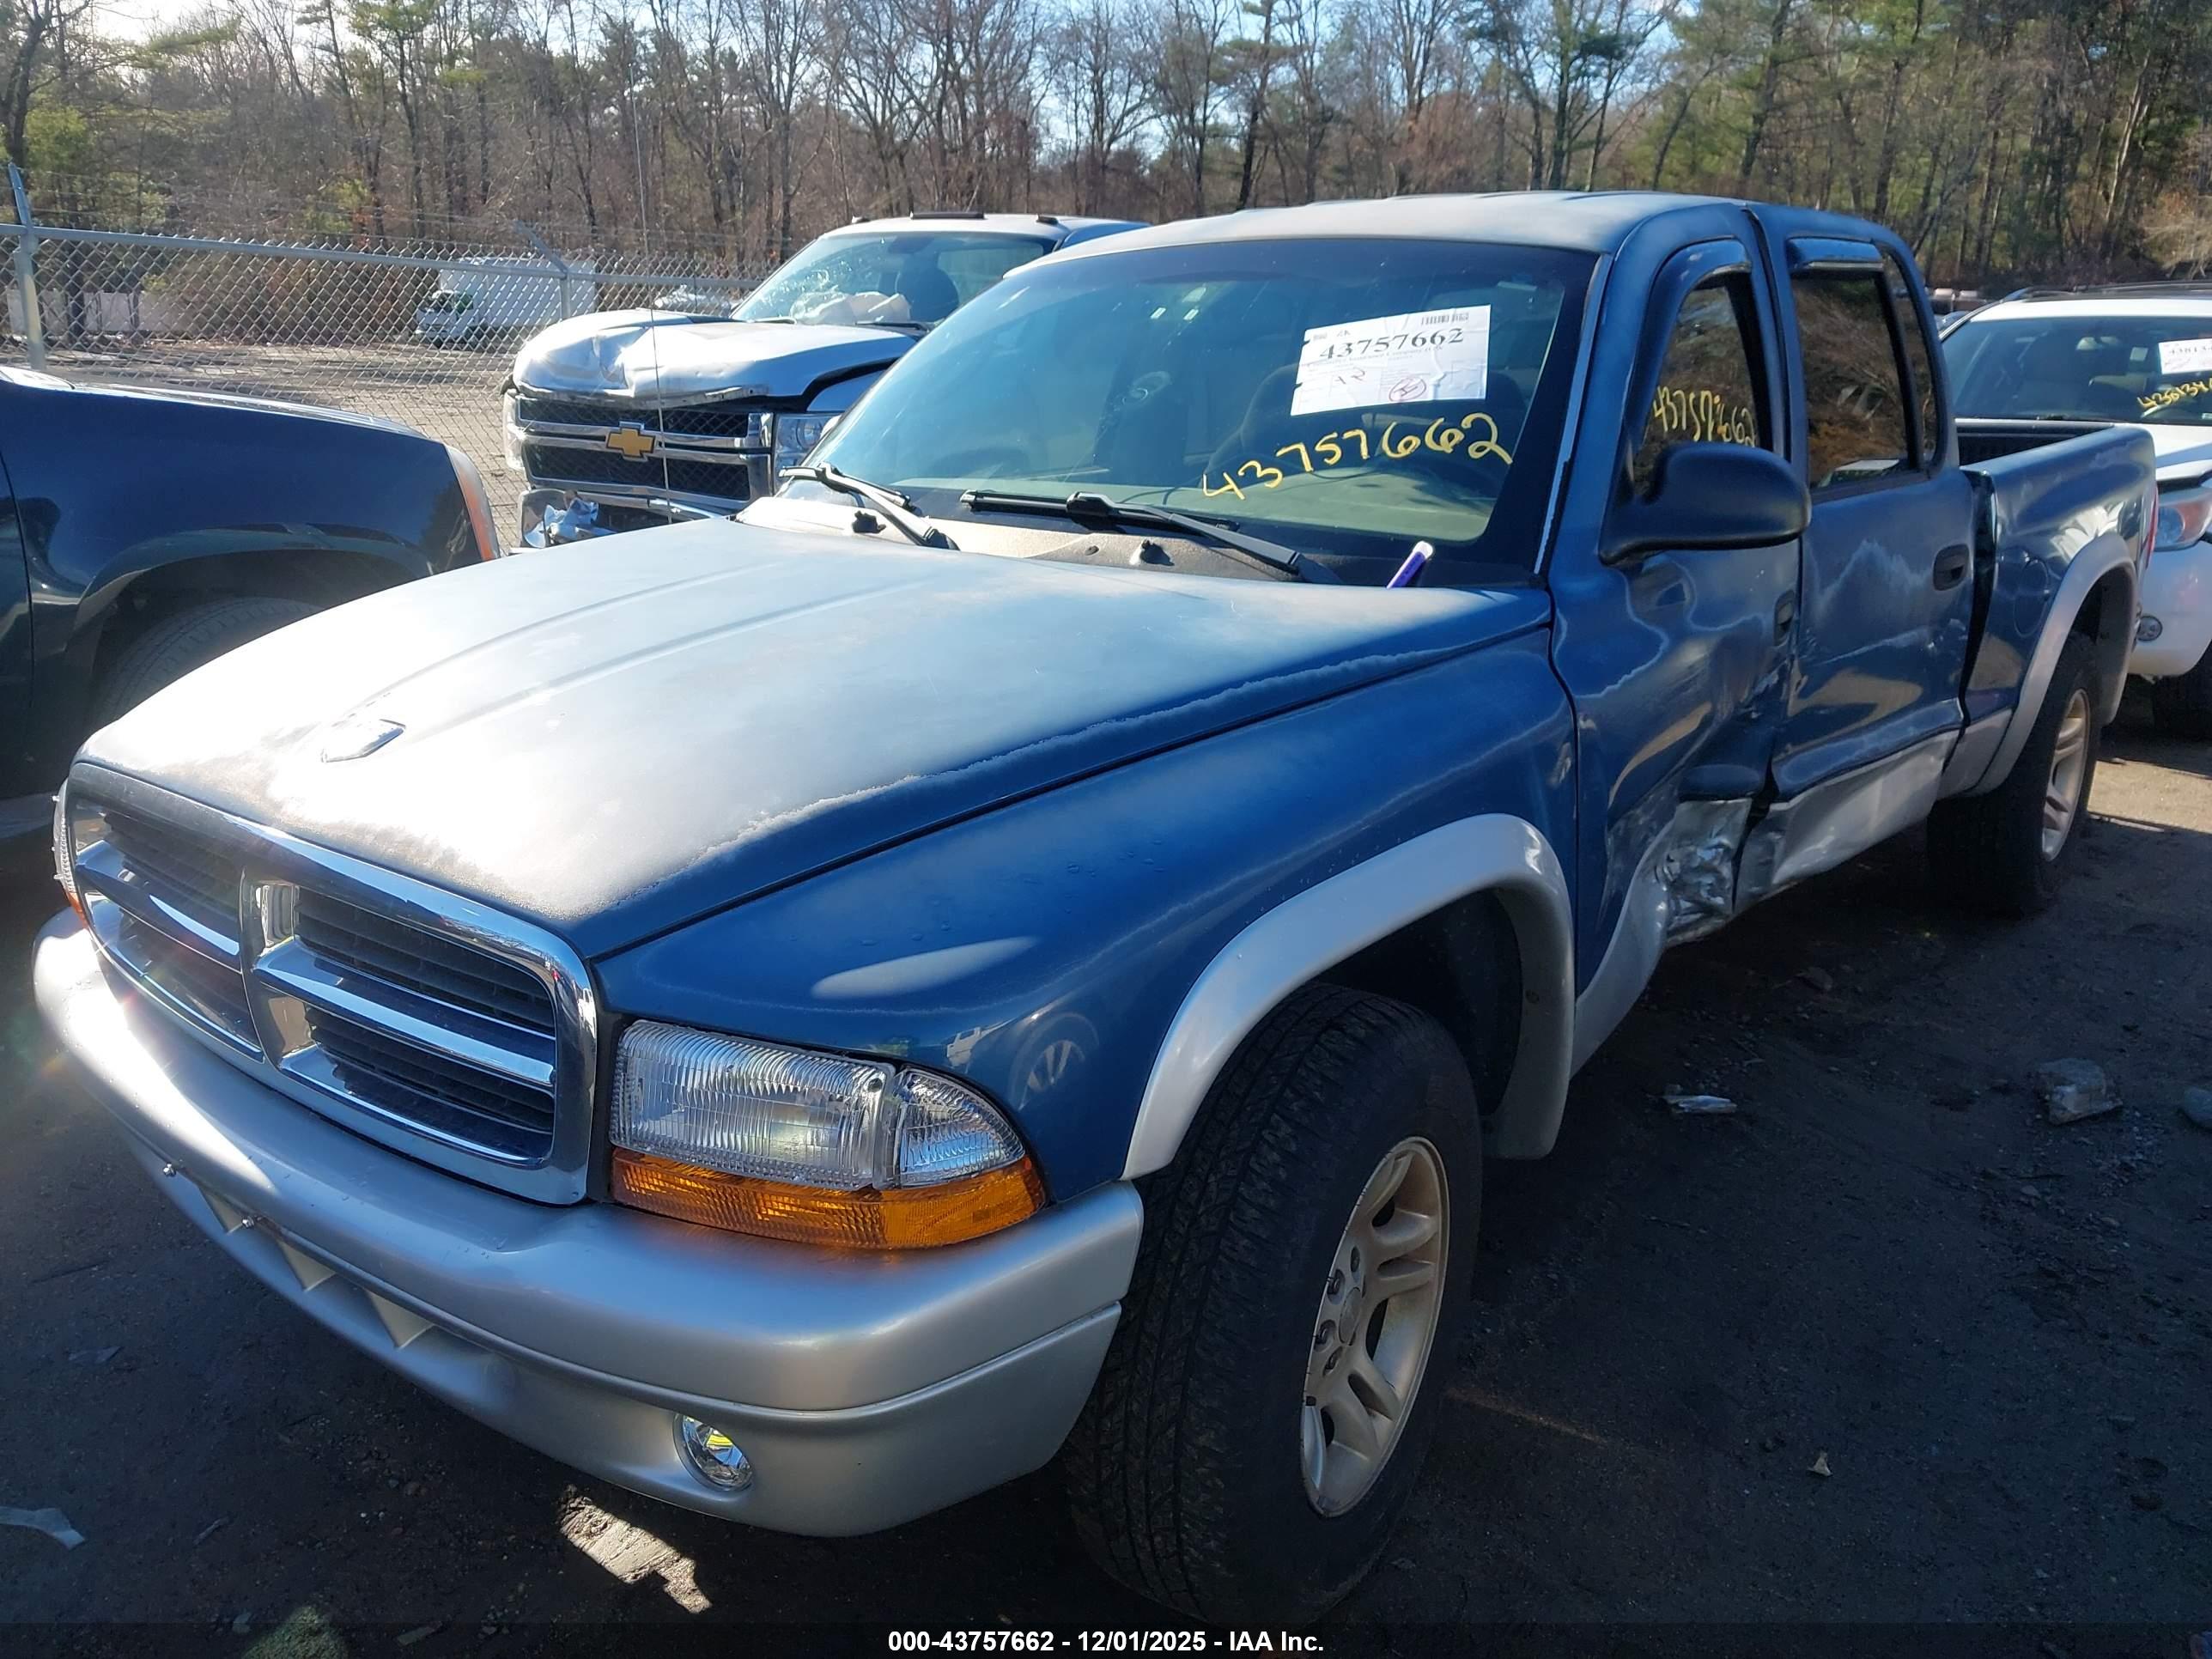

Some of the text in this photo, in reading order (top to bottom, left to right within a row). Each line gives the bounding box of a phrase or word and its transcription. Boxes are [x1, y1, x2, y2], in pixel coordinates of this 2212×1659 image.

[1319, 327, 1464, 360] 43757662
[1653, 386, 1756, 448] 43757662
[1202, 412, 1514, 501] 43757662
